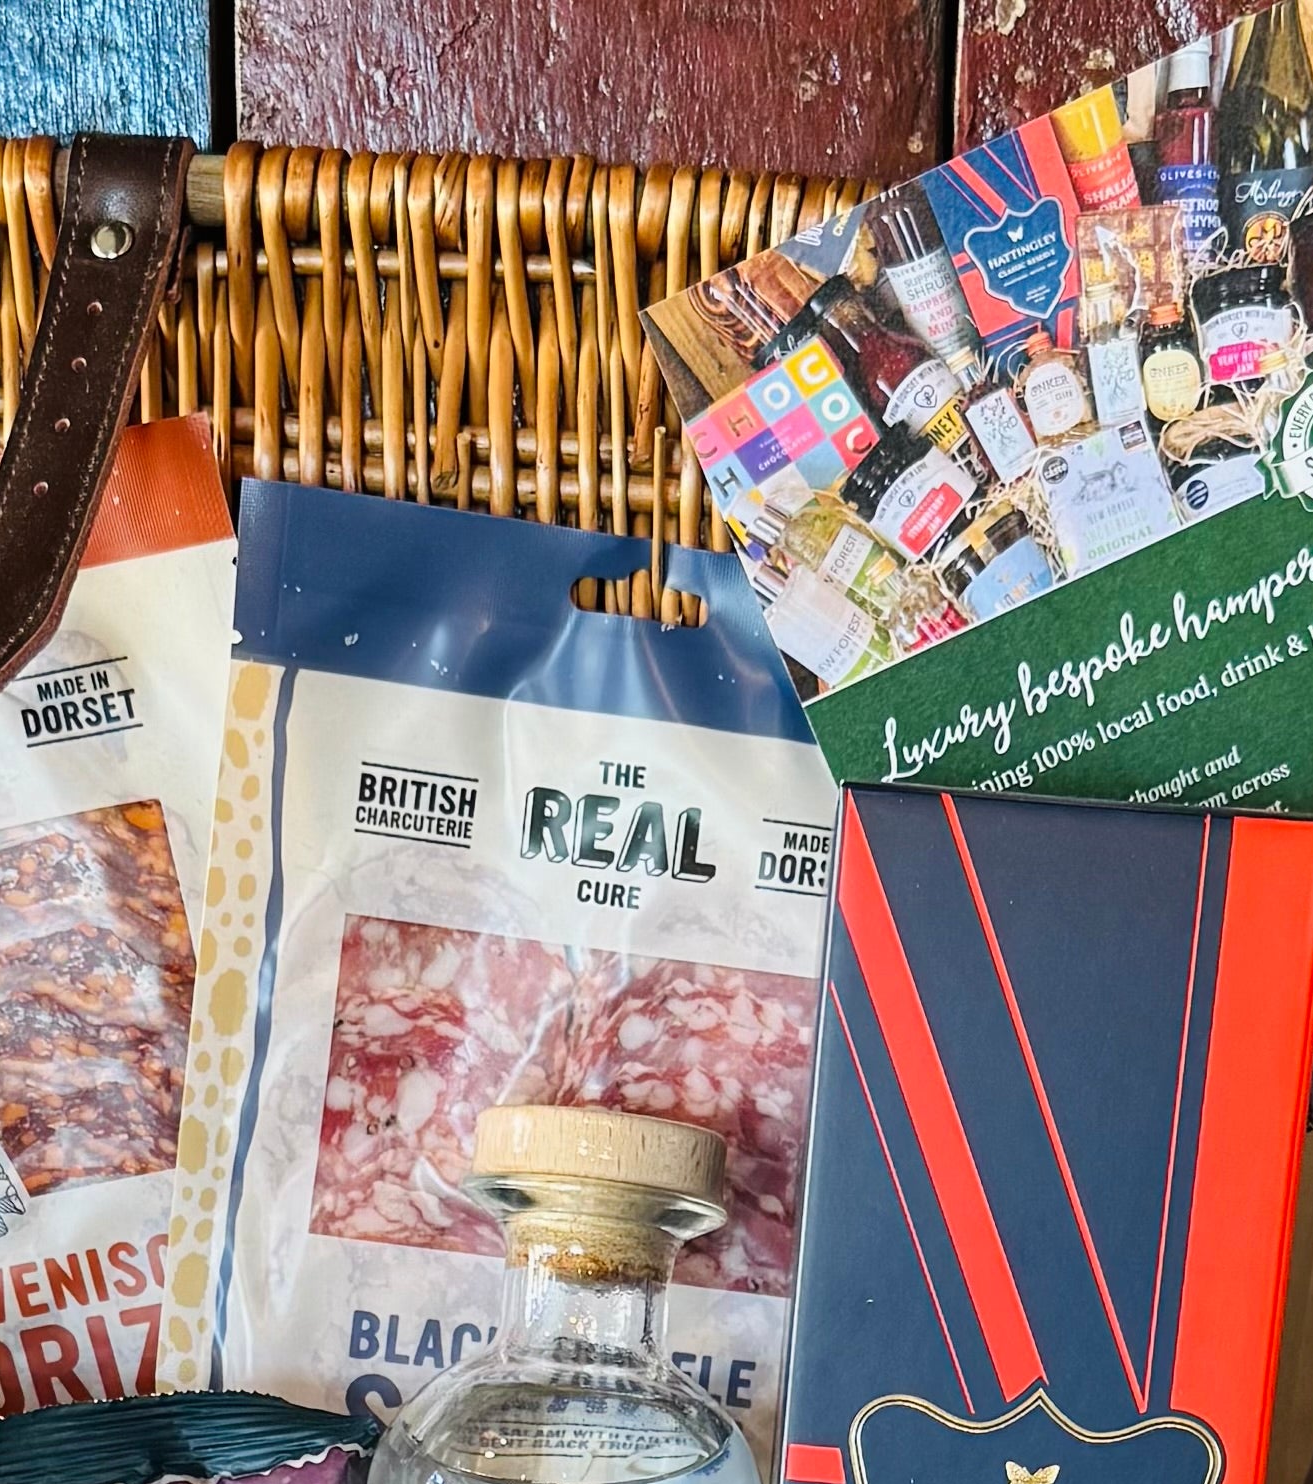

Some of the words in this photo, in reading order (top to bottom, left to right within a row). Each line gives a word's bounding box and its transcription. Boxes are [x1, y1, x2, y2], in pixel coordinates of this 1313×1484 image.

[1290, 401, 1313, 439] EVERY
[21, 689, 137, 738] DORSET
[881, 699, 1016, 783] Luxury
[1018, 610, 1171, 714] bespoke
[1030, 731, 1095, 776] 100%
[1096, 700, 1154, 745] local
[1155, 676, 1217, 724] food,
[1220, 645, 1283, 689] drink
[358, 772, 478, 818] BRITISH
[599, 761, 647, 789] THE
[355, 807, 473, 840] CHARCUTERIE
[520, 786, 716, 884] REAL
